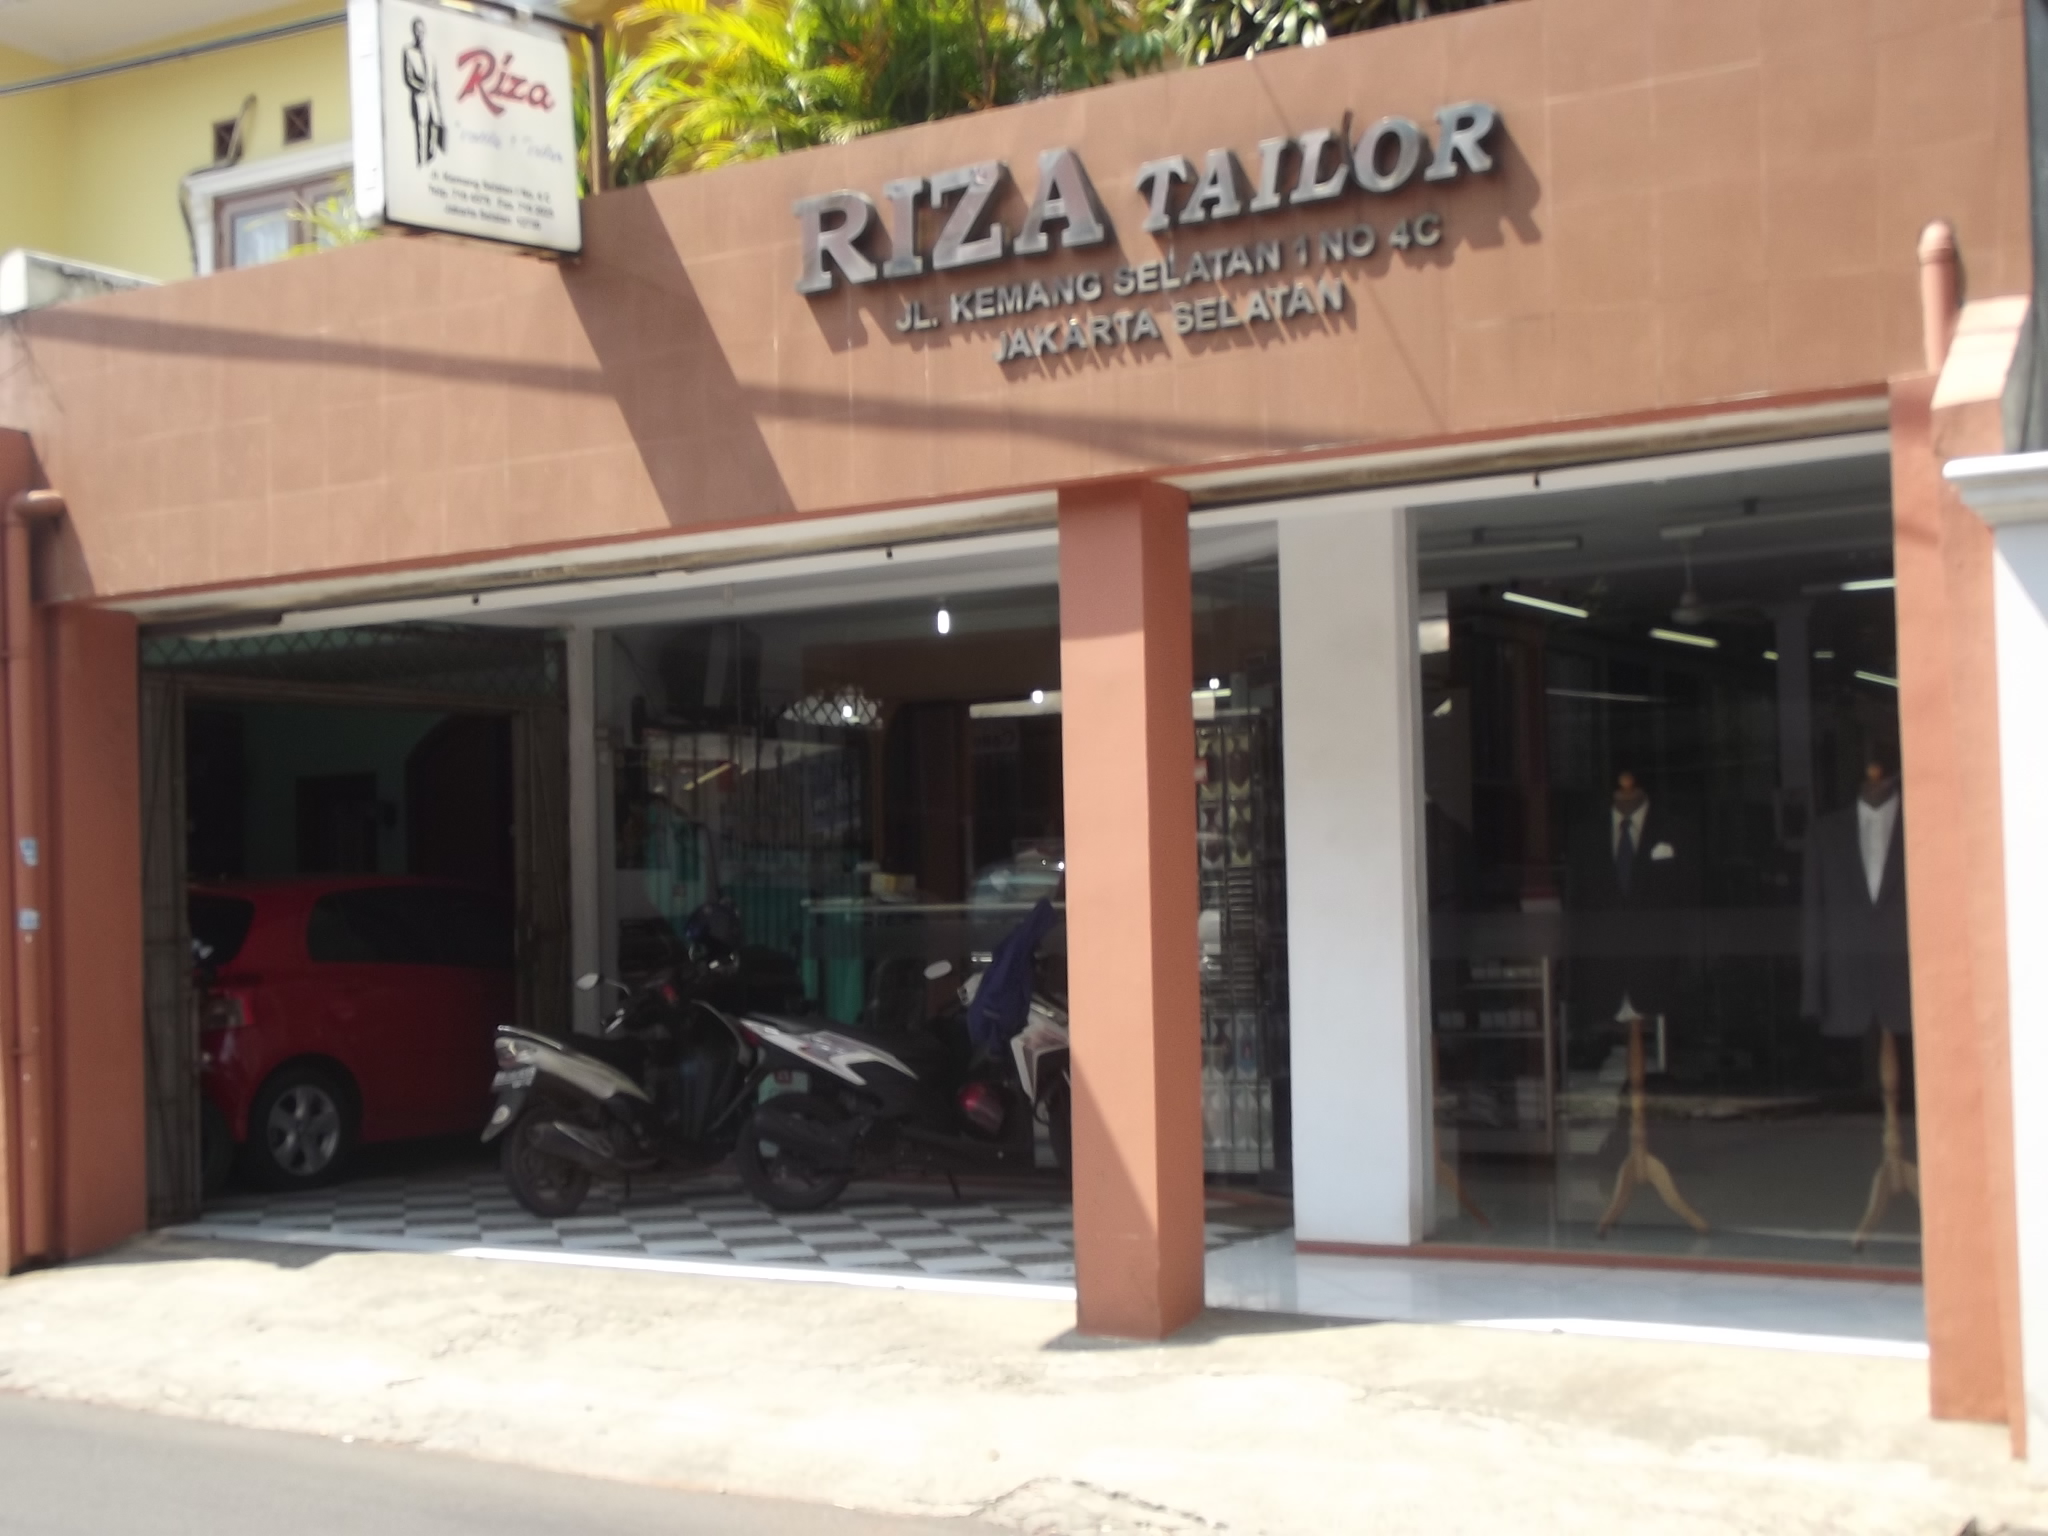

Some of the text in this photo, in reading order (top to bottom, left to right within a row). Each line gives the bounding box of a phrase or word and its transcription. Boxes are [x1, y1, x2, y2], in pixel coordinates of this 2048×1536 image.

[457, 47, 555, 117] Riza
[793, 100, 1498, 293] RIZA TAILOR
[896, 302, 940, 332] JL.
[951, 271, 1103, 323] KEMANG
[1113, 241, 1281, 297] SELATAN
[1319, 224, 1376, 262] NO
[1389, 212, 1442, 250] 4C
[994, 278, 1346, 364] JAKARTA SELATAN
